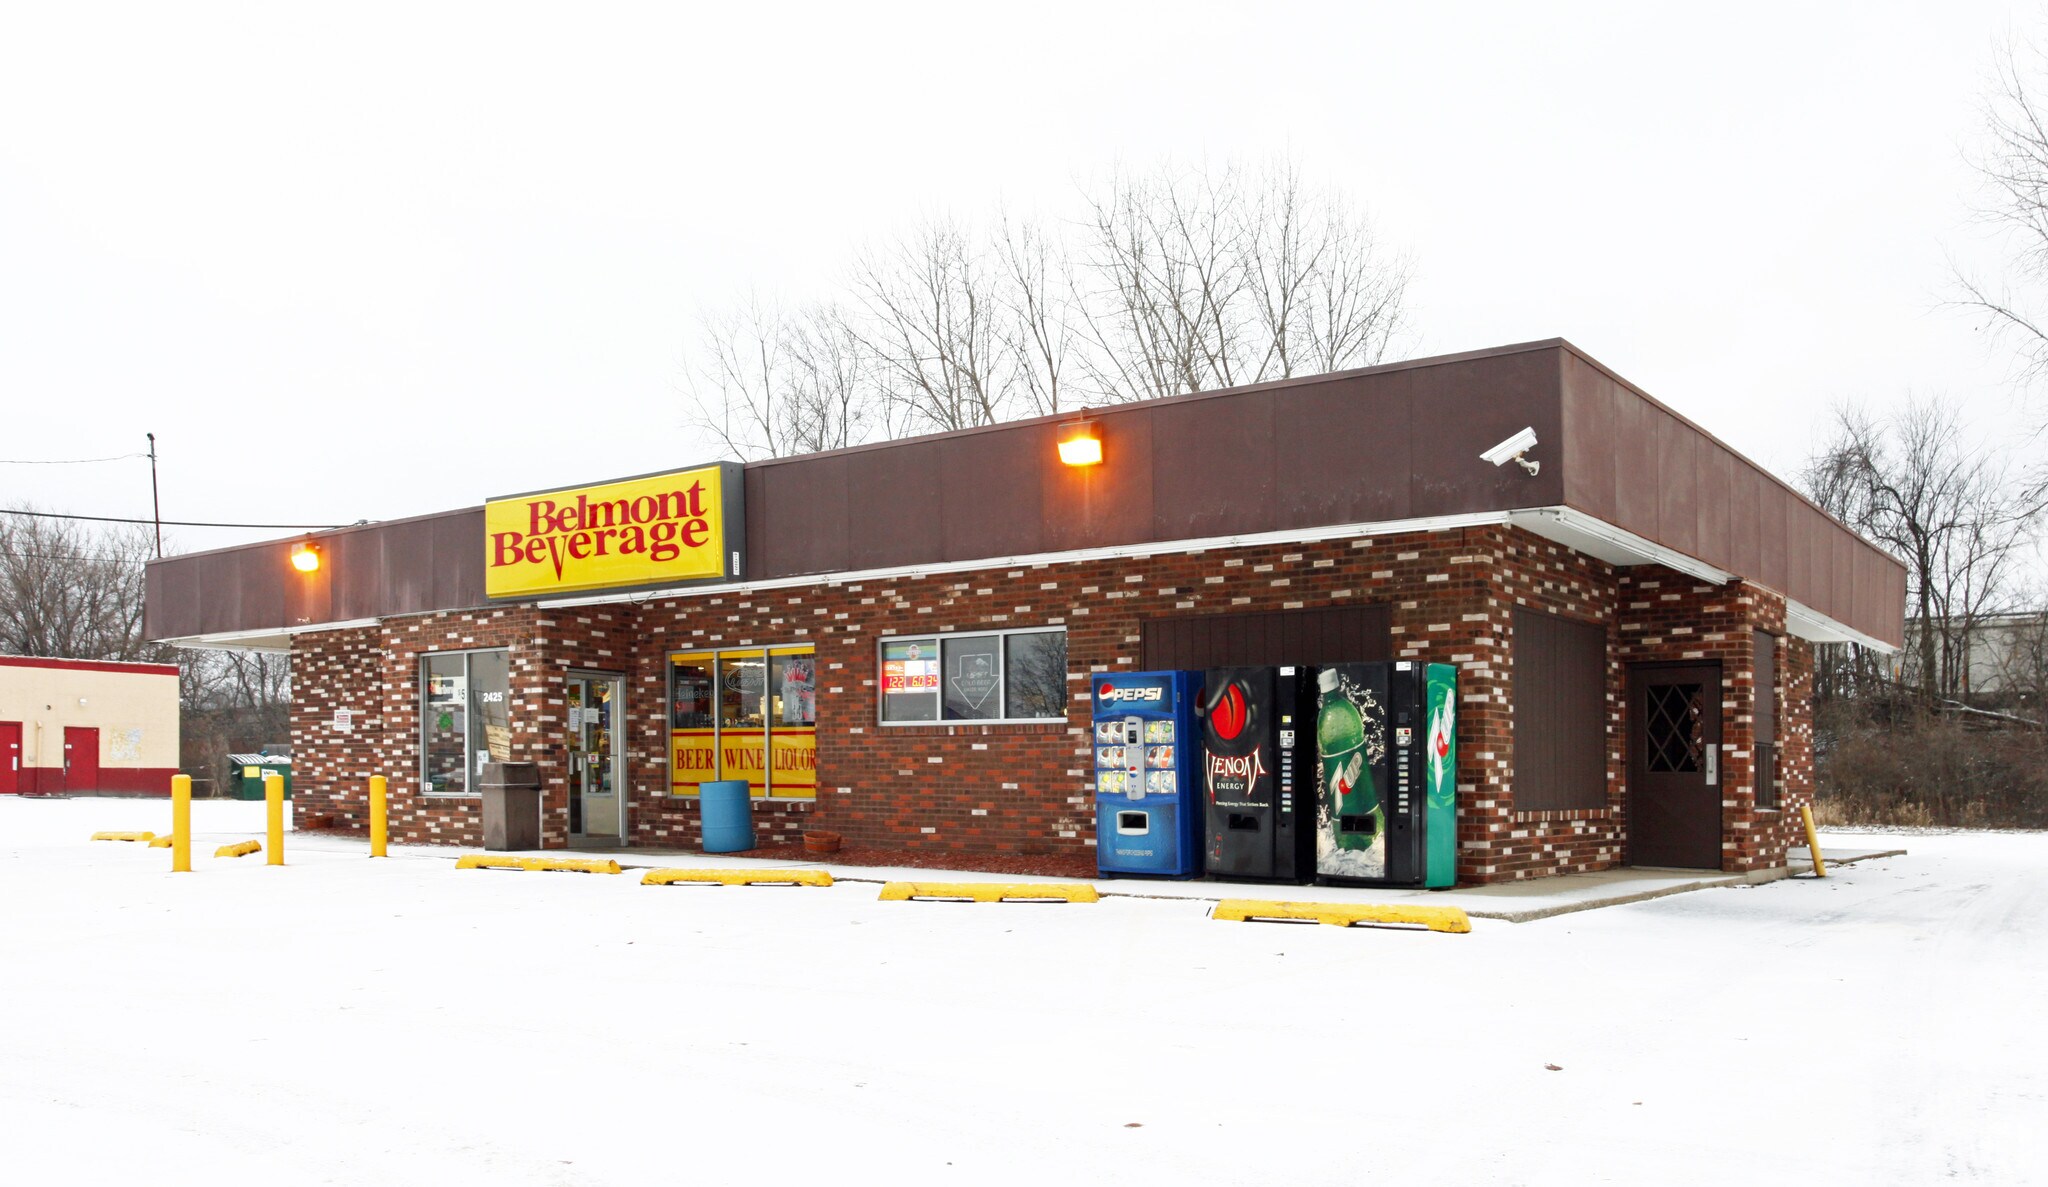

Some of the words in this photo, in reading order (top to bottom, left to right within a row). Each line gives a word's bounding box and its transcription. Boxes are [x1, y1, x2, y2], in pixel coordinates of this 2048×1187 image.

[526, 479, 707, 537] Belmont
[490, 518, 709, 582] Beverage
[483, 692, 503, 702] 2425
[1113, 687, 1163, 701] PEPSI
[676, 748, 715, 770] BEER
[725, 748, 765, 770] WINE
[775, 748, 816, 771] LIQUOR
[1205, 747, 1266, 795] VENOM
[1216, 782, 1245, 790] ENERGY
